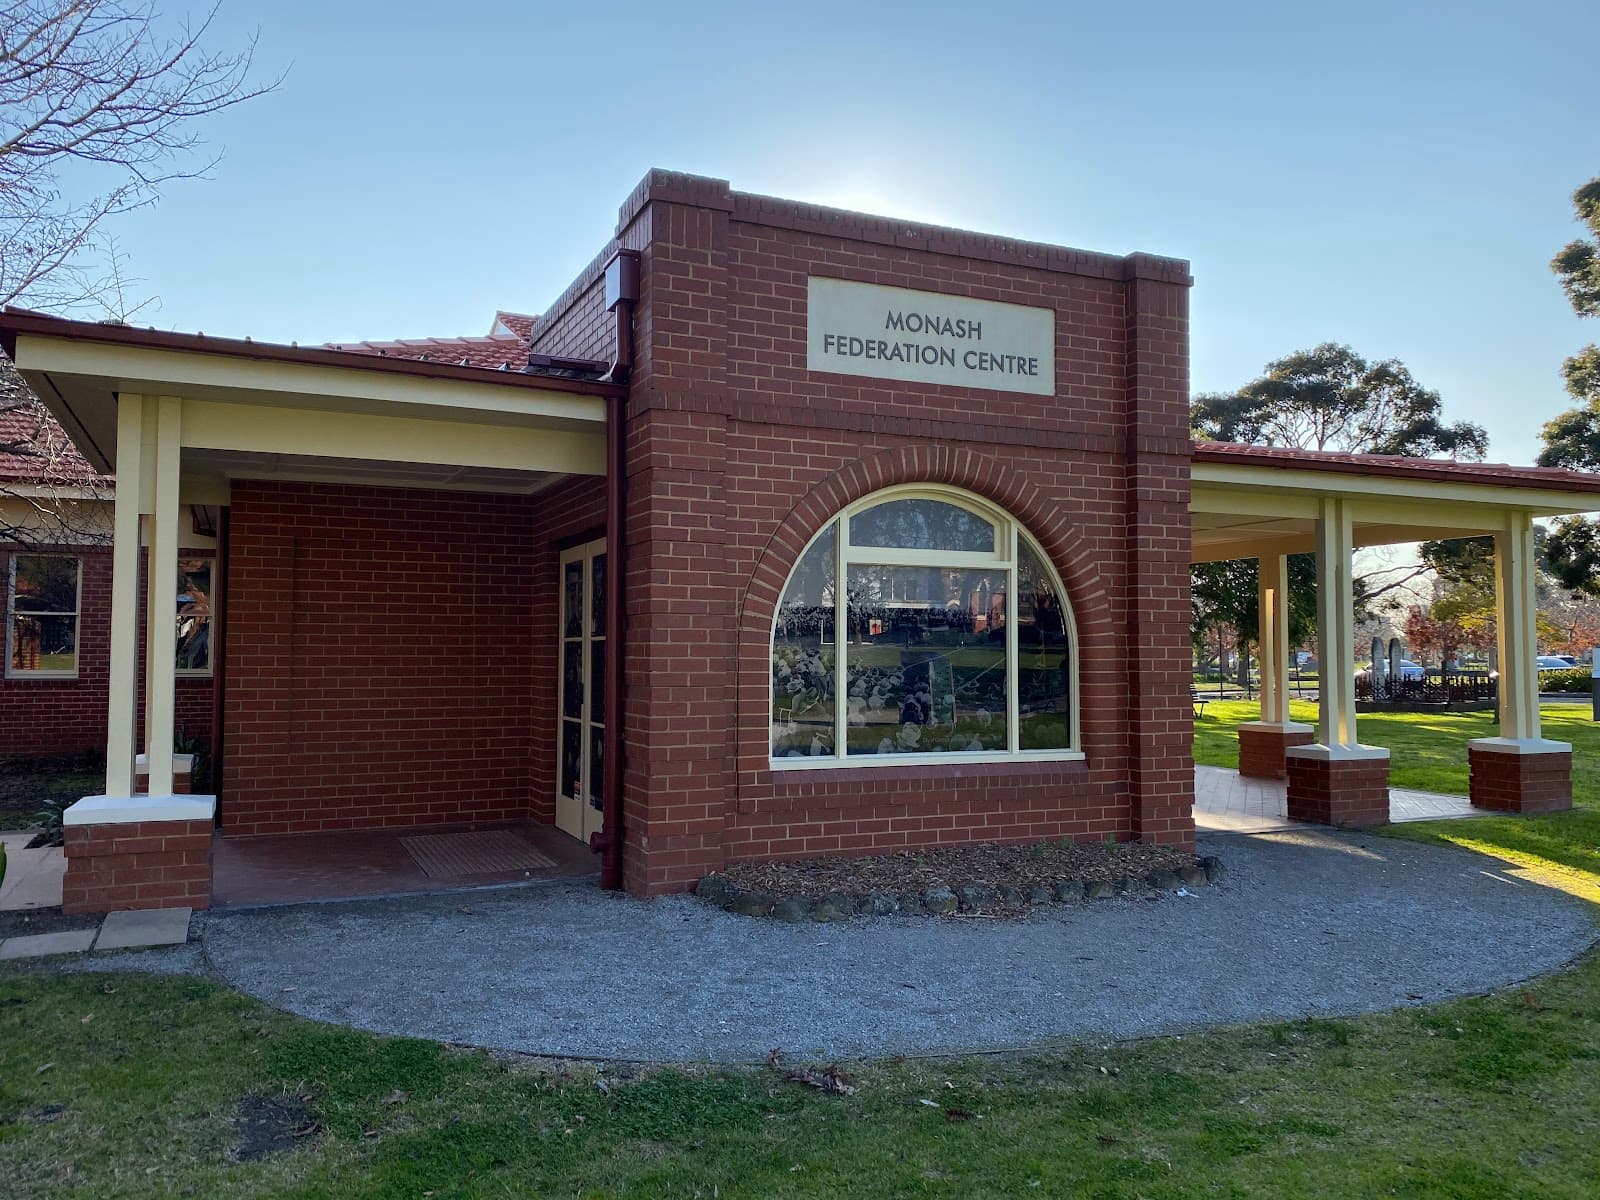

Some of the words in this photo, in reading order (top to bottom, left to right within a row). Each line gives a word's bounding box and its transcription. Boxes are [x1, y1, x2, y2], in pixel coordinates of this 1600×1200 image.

[886, 310, 982, 340] MONASH
[824, 333, 955, 367] FEDERATION
[963, 350, 1038, 376] CENTRE
